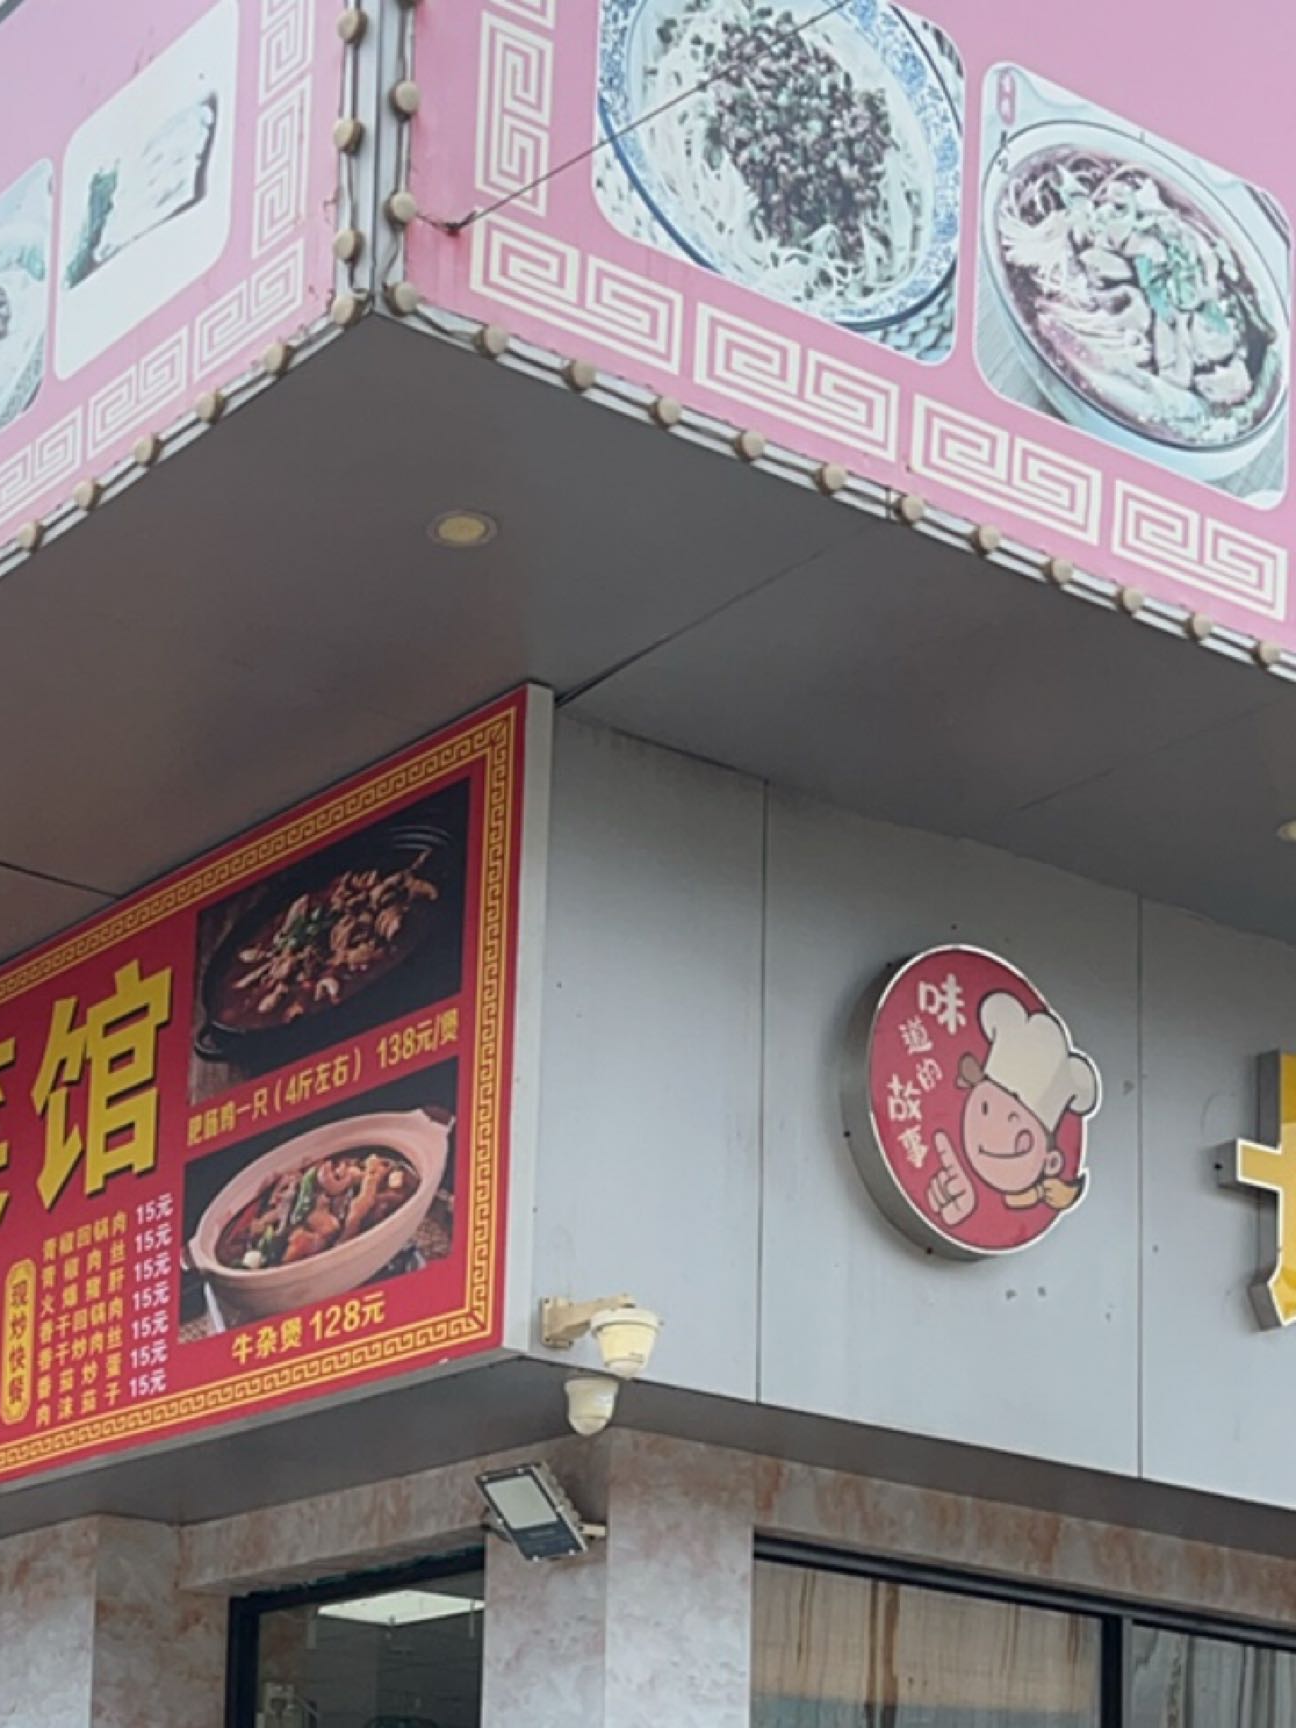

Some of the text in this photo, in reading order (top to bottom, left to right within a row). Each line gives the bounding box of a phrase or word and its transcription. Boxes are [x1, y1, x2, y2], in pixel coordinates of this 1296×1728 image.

[136, 1193, 174, 1224] 15元
[135, 1222, 173, 1252] 15元
[134, 1252, 172, 1282] 15元
[132, 1281, 170, 1311] 15元
[131, 1310, 169, 1340] 15元
[309, 1291, 386, 1340] 128元
[130, 1339, 168, 1369] 15元
[129, 1368, 167, 1397] 15元
